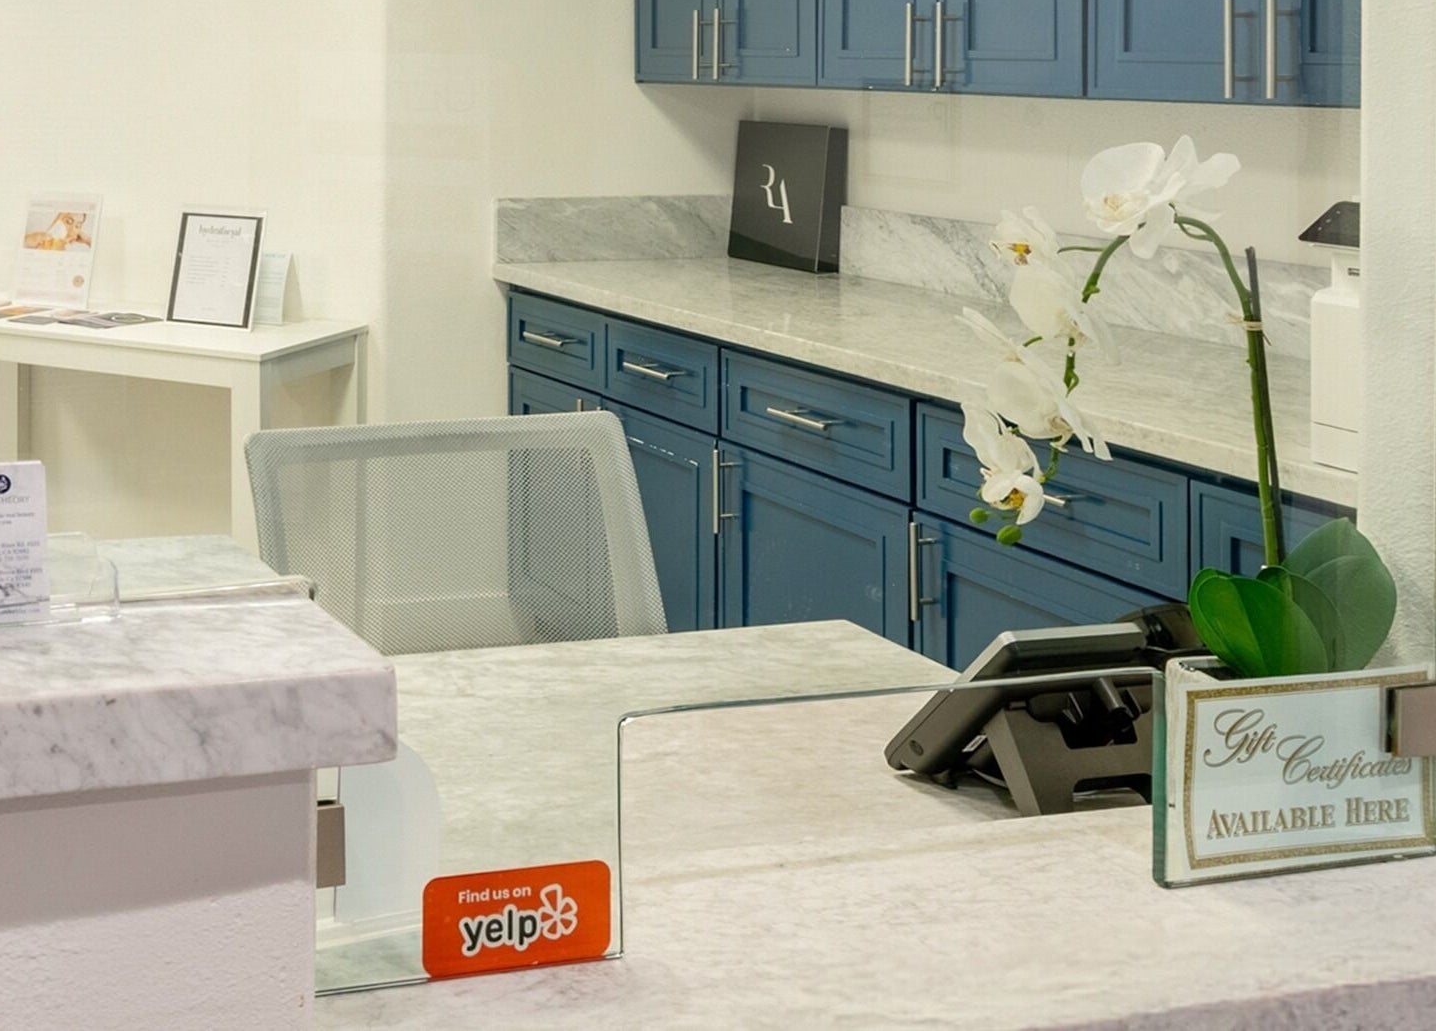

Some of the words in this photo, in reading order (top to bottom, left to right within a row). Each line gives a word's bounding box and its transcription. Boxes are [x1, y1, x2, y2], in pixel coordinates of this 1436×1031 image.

[1203, 708, 1279, 768] Gift
[1275, 734, 1413, 790] Certificates
[1206, 804, 1336, 840] AVAILABLE
[1344, 797, 1410, 827] HERE
[457, 888, 490, 904] Find
[492, 889, 510, 900] us
[512, 886, 532, 898] on
[462, 907, 539, 953] yelp
